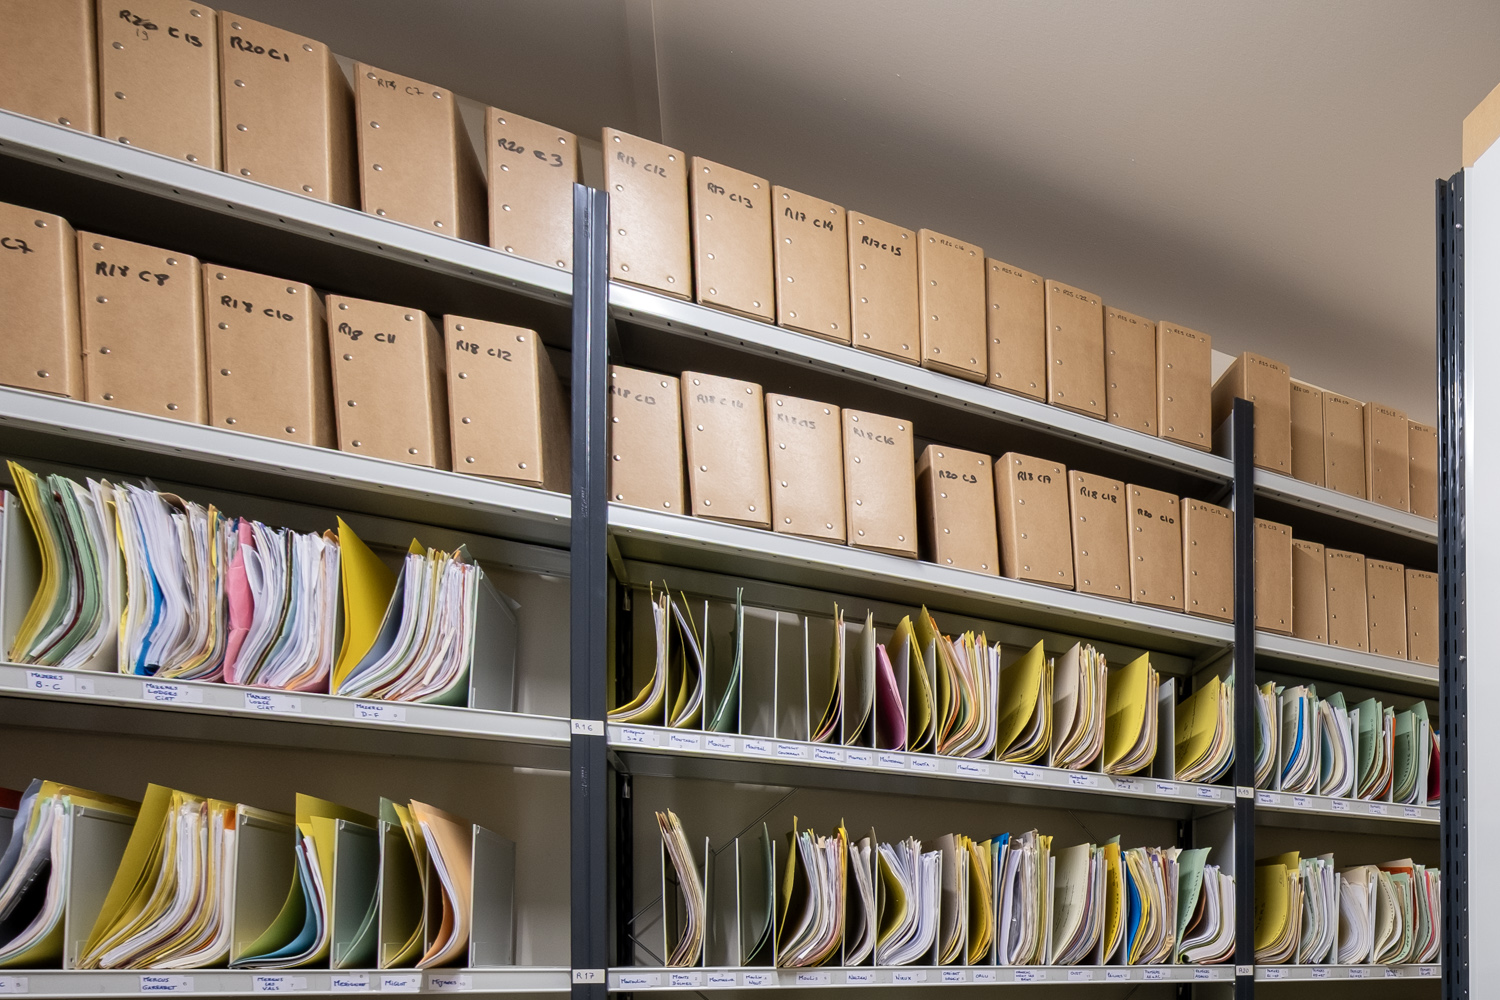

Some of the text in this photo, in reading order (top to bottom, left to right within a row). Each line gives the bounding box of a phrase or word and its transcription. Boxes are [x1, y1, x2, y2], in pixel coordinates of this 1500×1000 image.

[616, 150, 637, 167] R17
[706, 181, 726, 196] R17
[455, 339, 480, 355] R18
